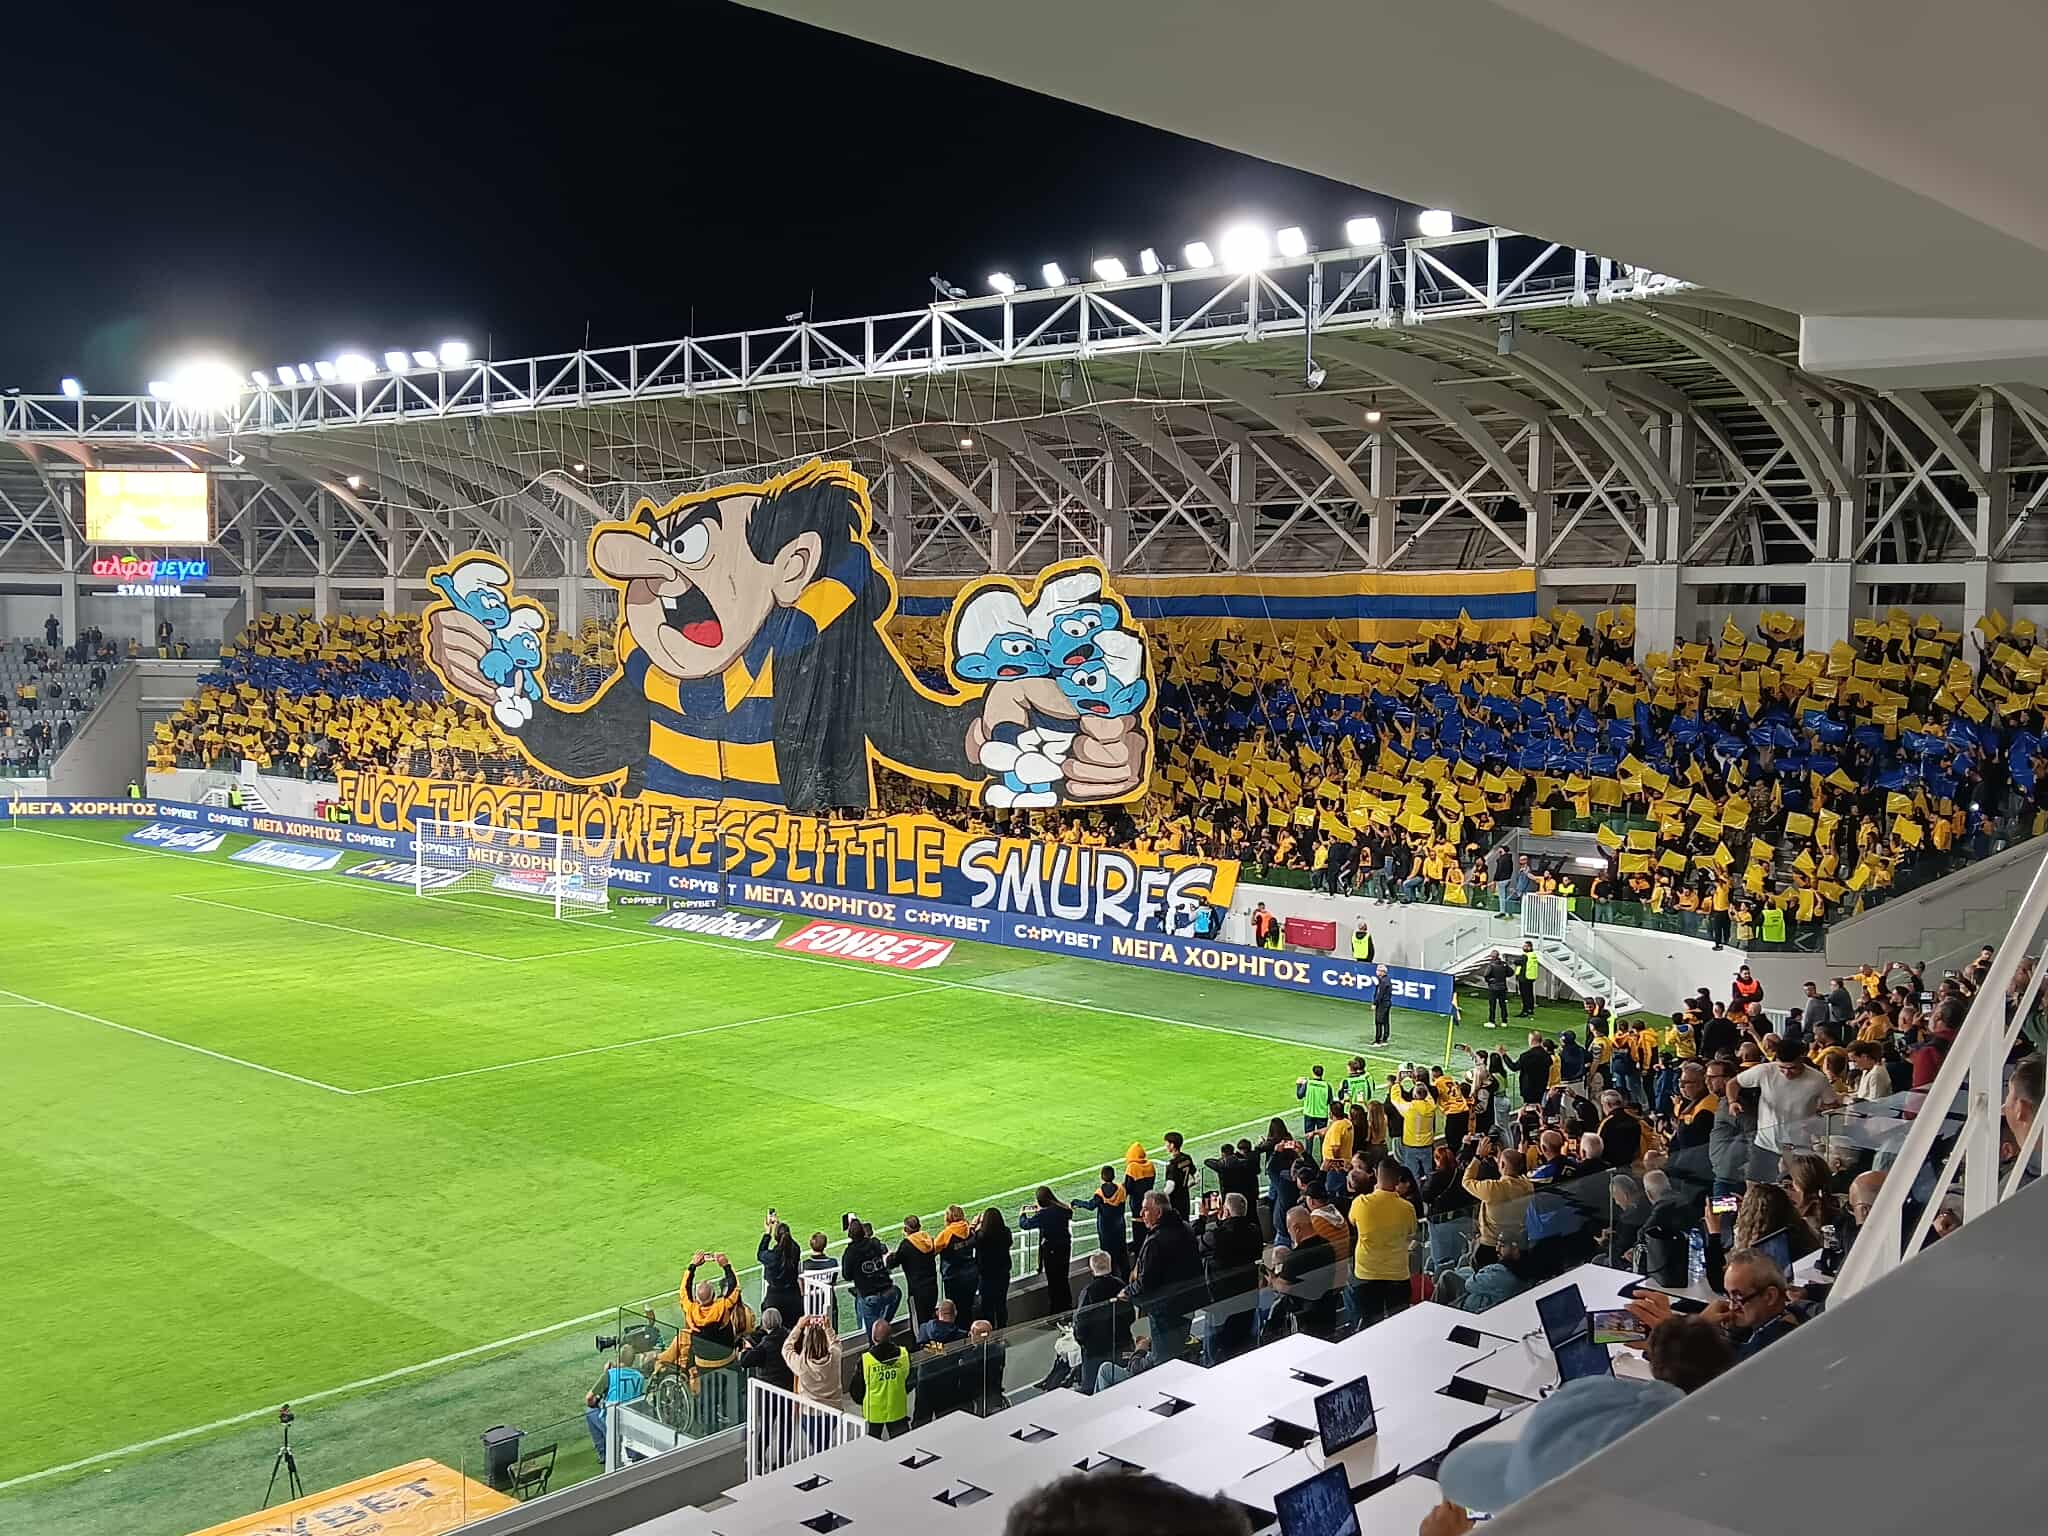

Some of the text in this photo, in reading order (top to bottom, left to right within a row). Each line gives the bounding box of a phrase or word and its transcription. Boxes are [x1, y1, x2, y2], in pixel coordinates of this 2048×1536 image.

[117, 585, 181, 597] STADIUM
[341, 773, 1219, 938] FUCK THOSE HOMELESS LITTLE SMURFS
[655, 911, 767, 940] novibet
[785, 925, 944, 965] FONBET
[619, 1377, 641, 1394] TV
[879, 1369, 897, 1382] 209
